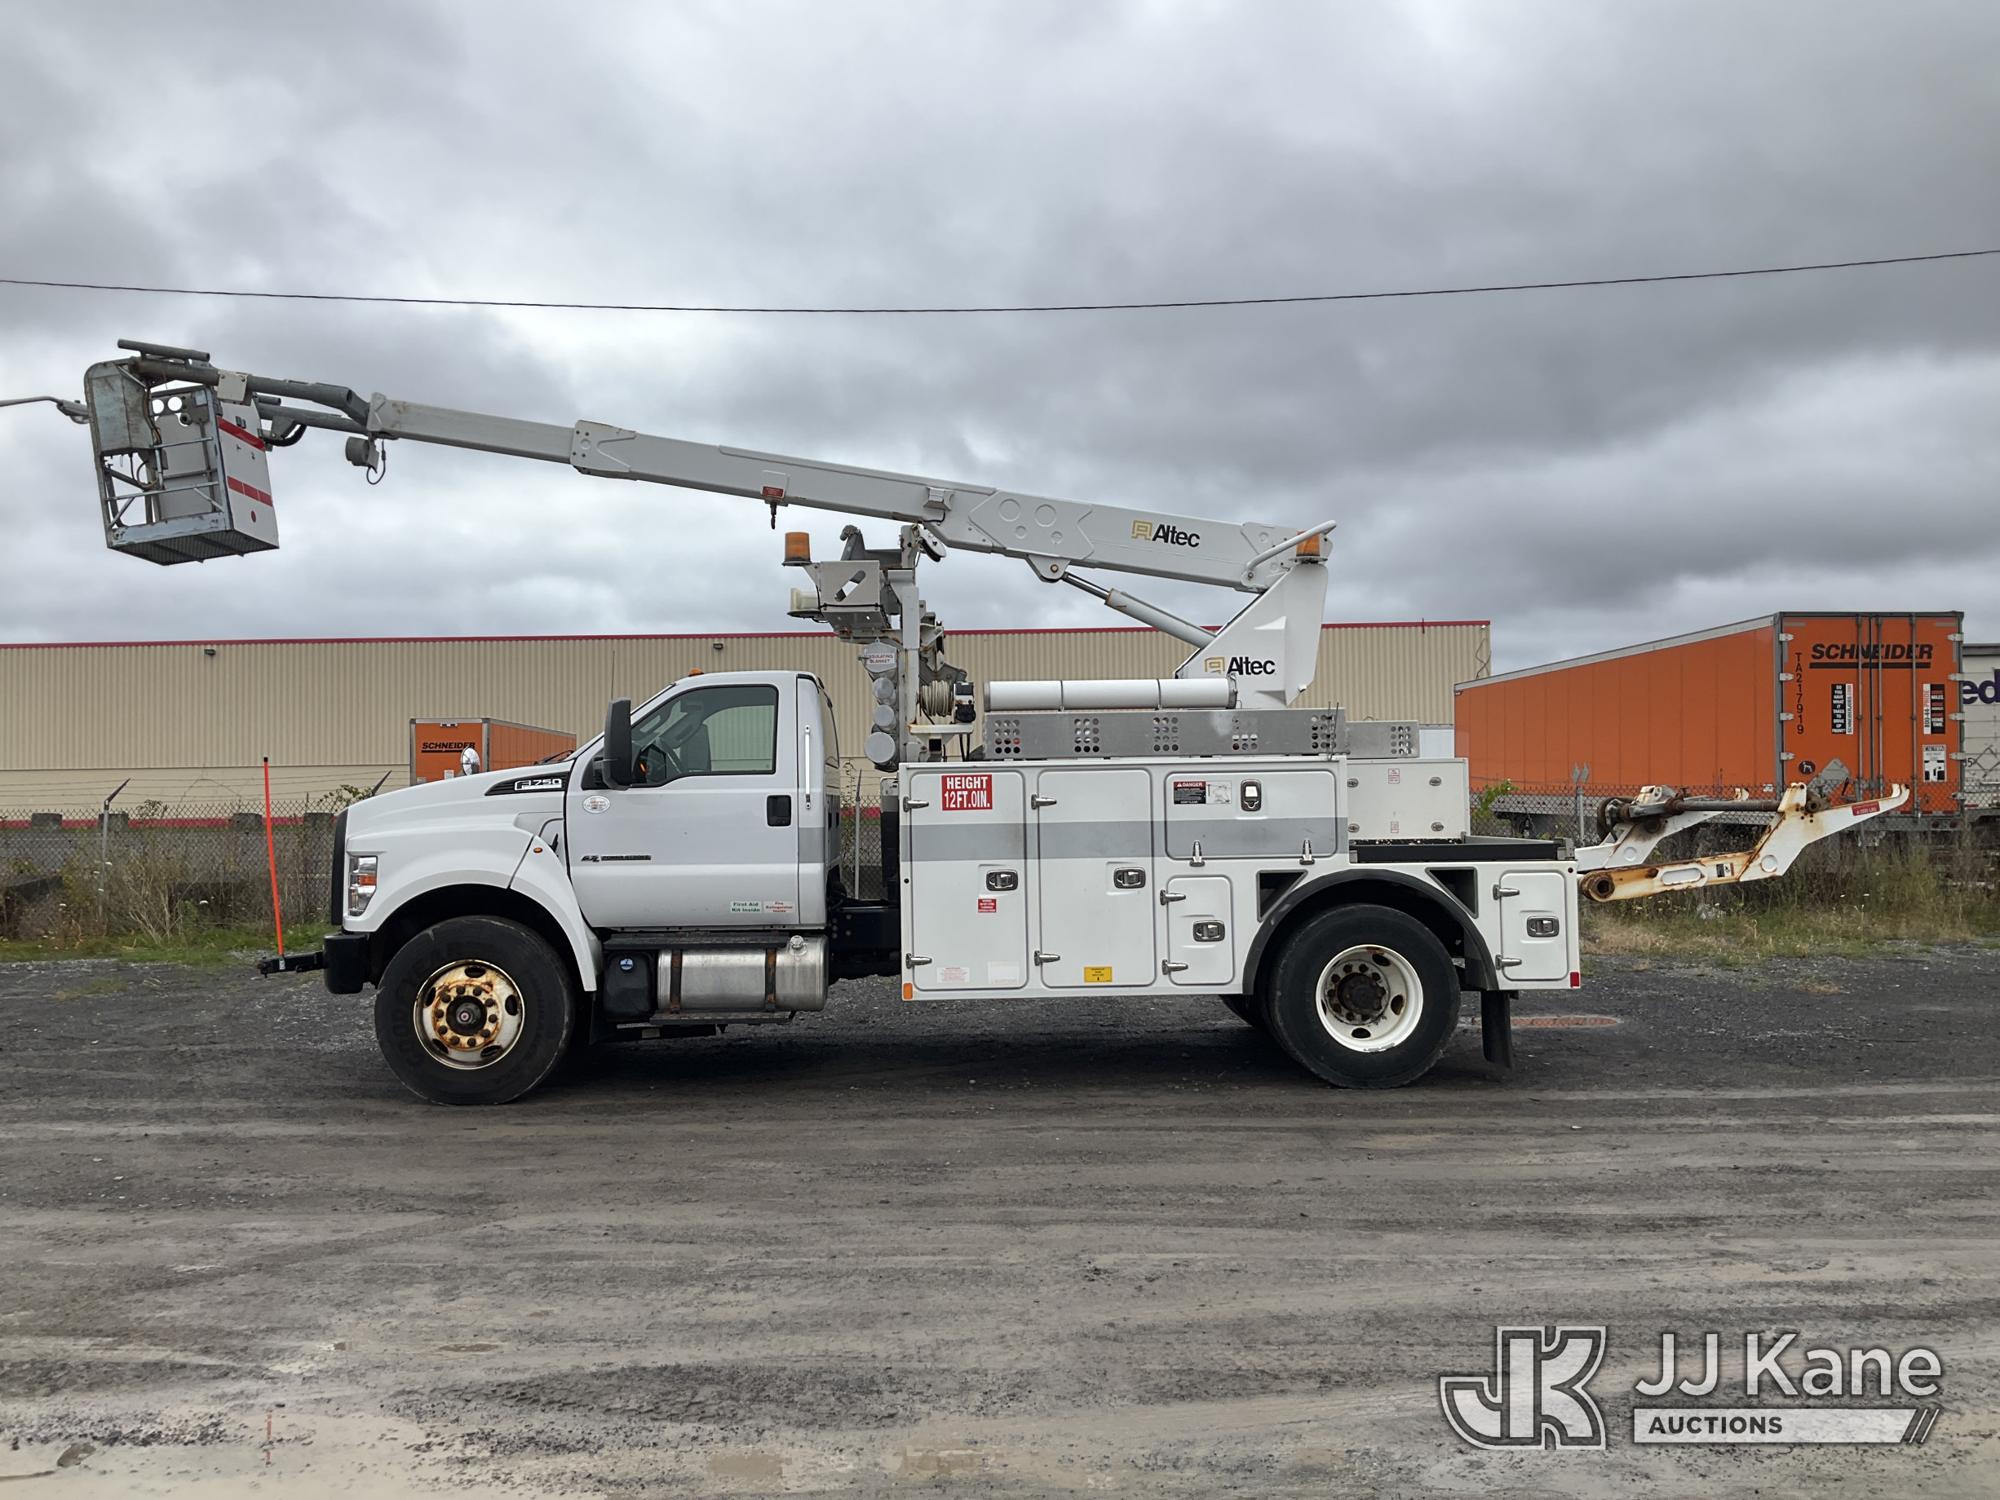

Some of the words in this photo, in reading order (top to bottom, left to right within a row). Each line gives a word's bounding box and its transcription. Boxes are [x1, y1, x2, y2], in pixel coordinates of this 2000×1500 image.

[1152, 524, 1200, 547] Altec
[1811, 643, 1933, 660] SCHNEIDER
[1226, 656, 1275, 675] Altec
[1795, 652, 1804, 734] TA217919
[946, 776, 988, 790] HEIGHT
